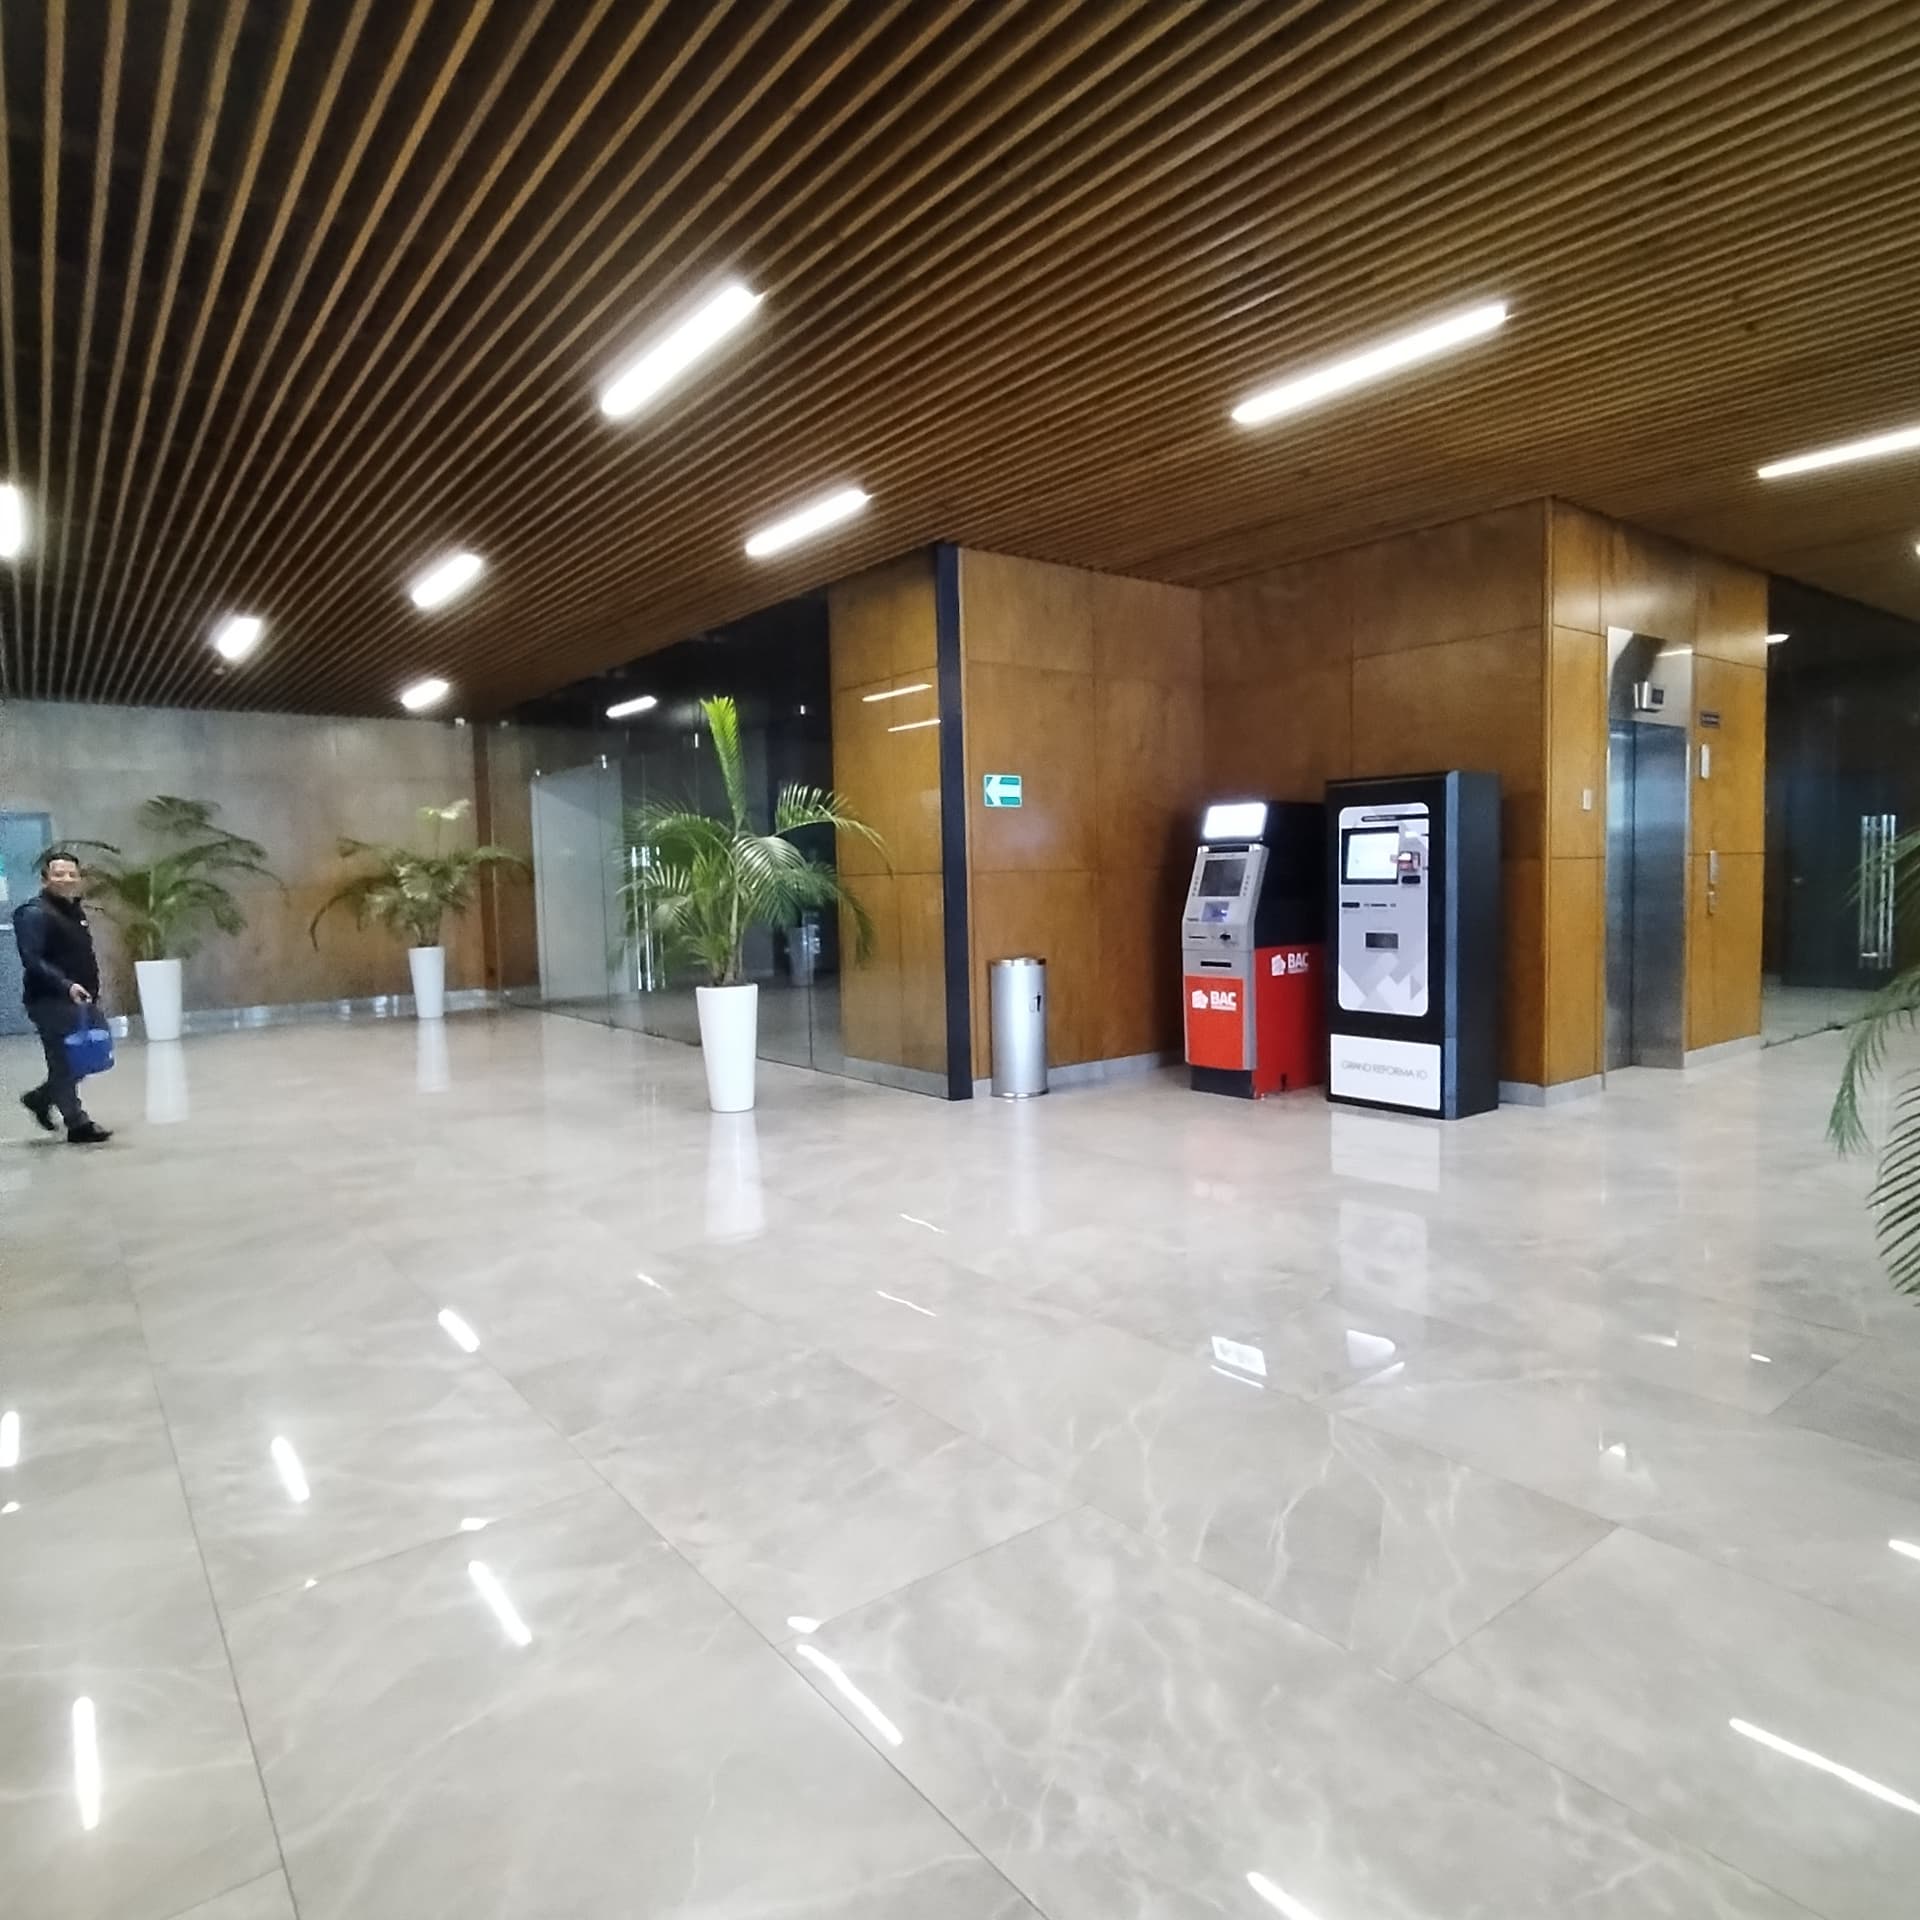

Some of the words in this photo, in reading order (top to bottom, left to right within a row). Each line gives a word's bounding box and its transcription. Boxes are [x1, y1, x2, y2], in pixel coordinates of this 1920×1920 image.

[1288, 952, 1309, 968] BAC
[1210, 990, 1237, 1006] BAC
[1342, 1060, 1372, 1073] GRAND
[1373, 1064, 1415, 1078] REFORMA
